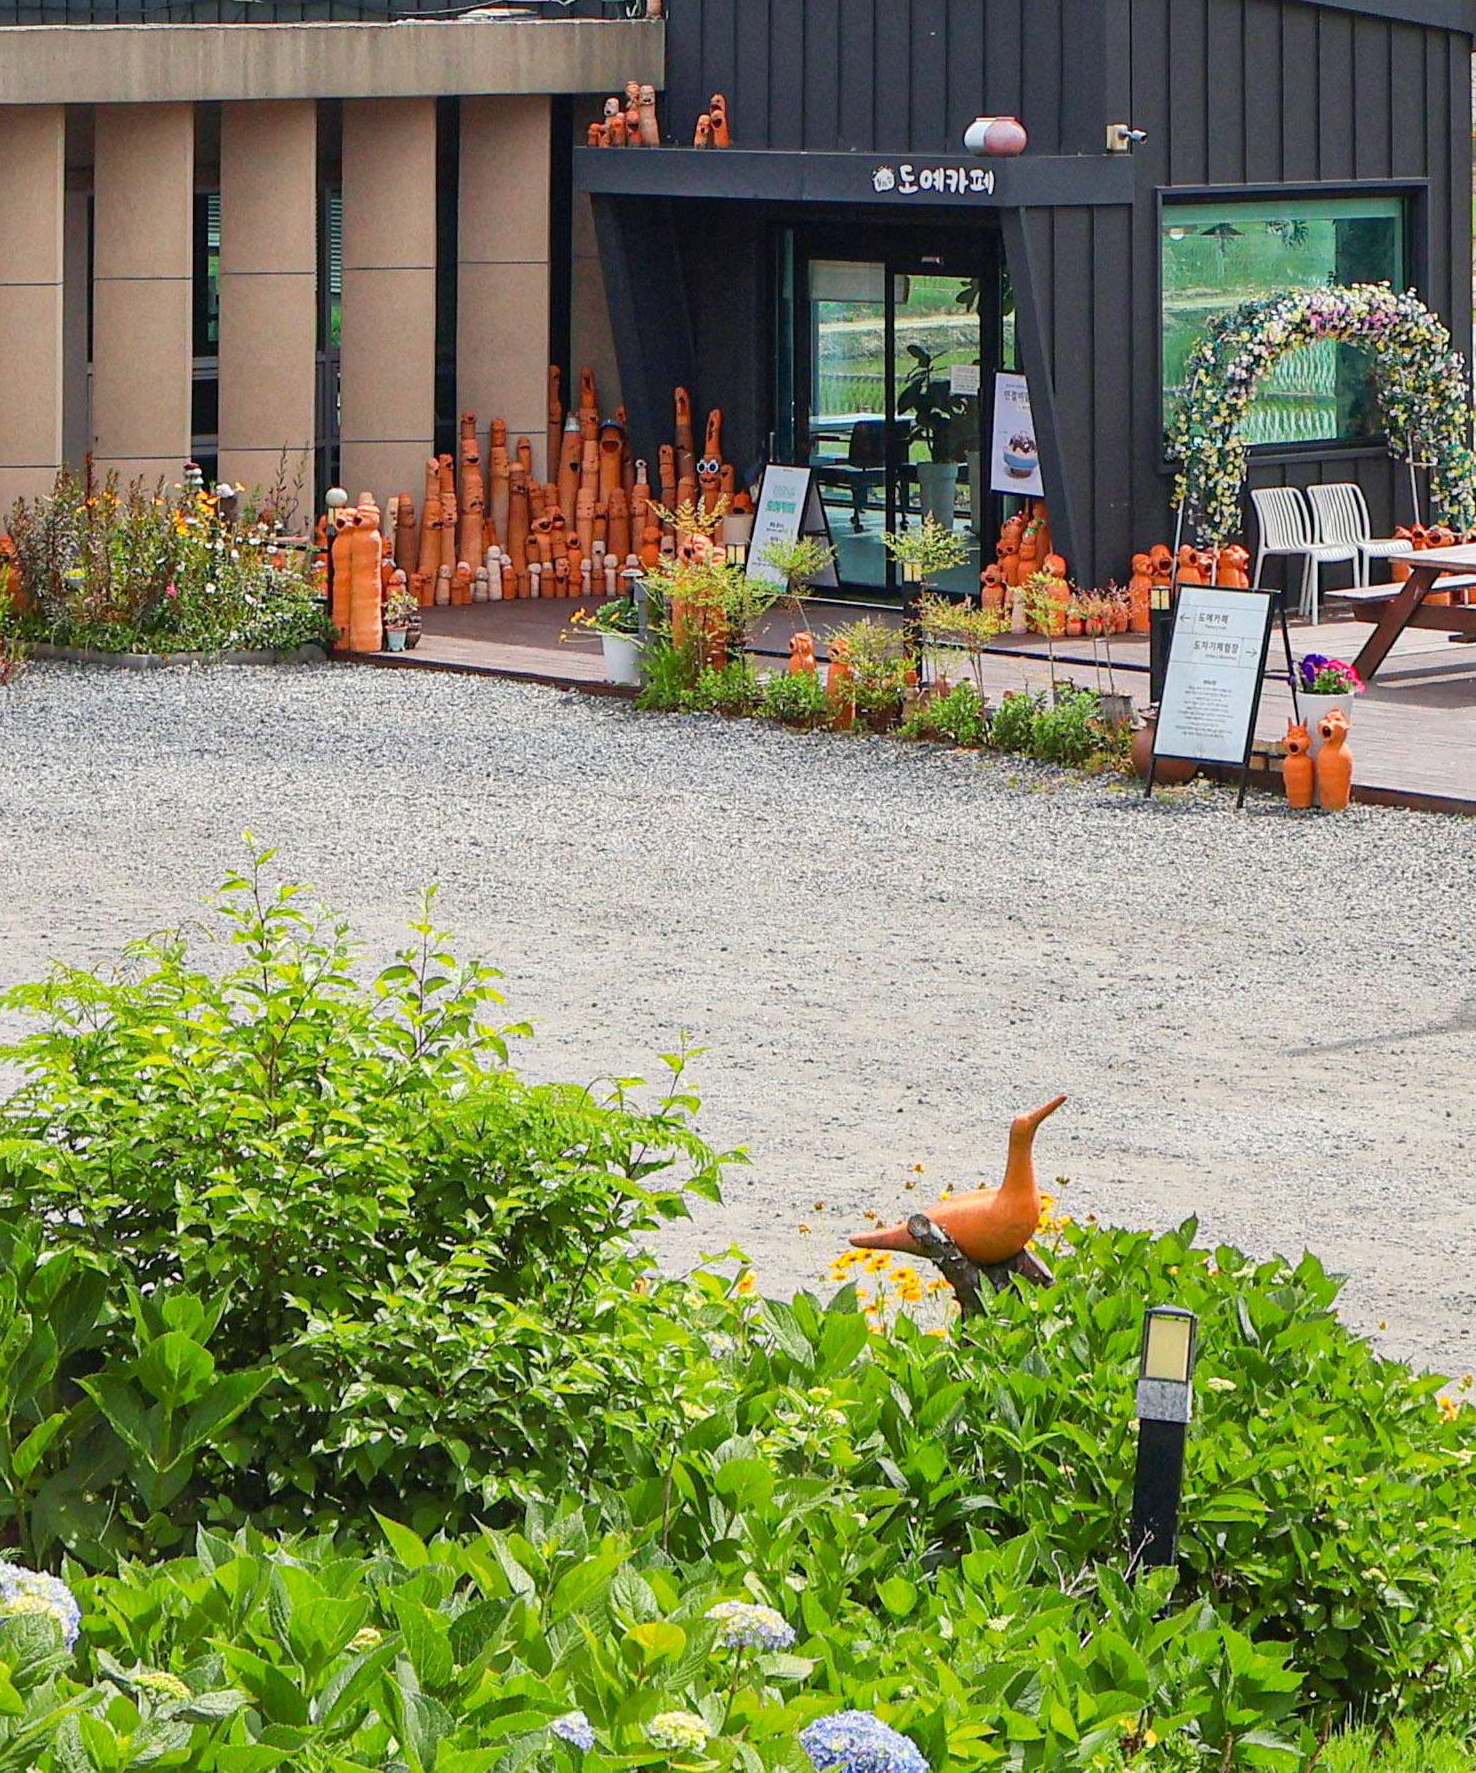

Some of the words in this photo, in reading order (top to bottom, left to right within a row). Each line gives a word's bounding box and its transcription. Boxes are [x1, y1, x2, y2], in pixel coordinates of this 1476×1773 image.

[897, 163, 995, 196] 도예카페
[1198, 613, 1229, 624] 도예카페
[1193, 640, 1239, 654] 도자기체험장
